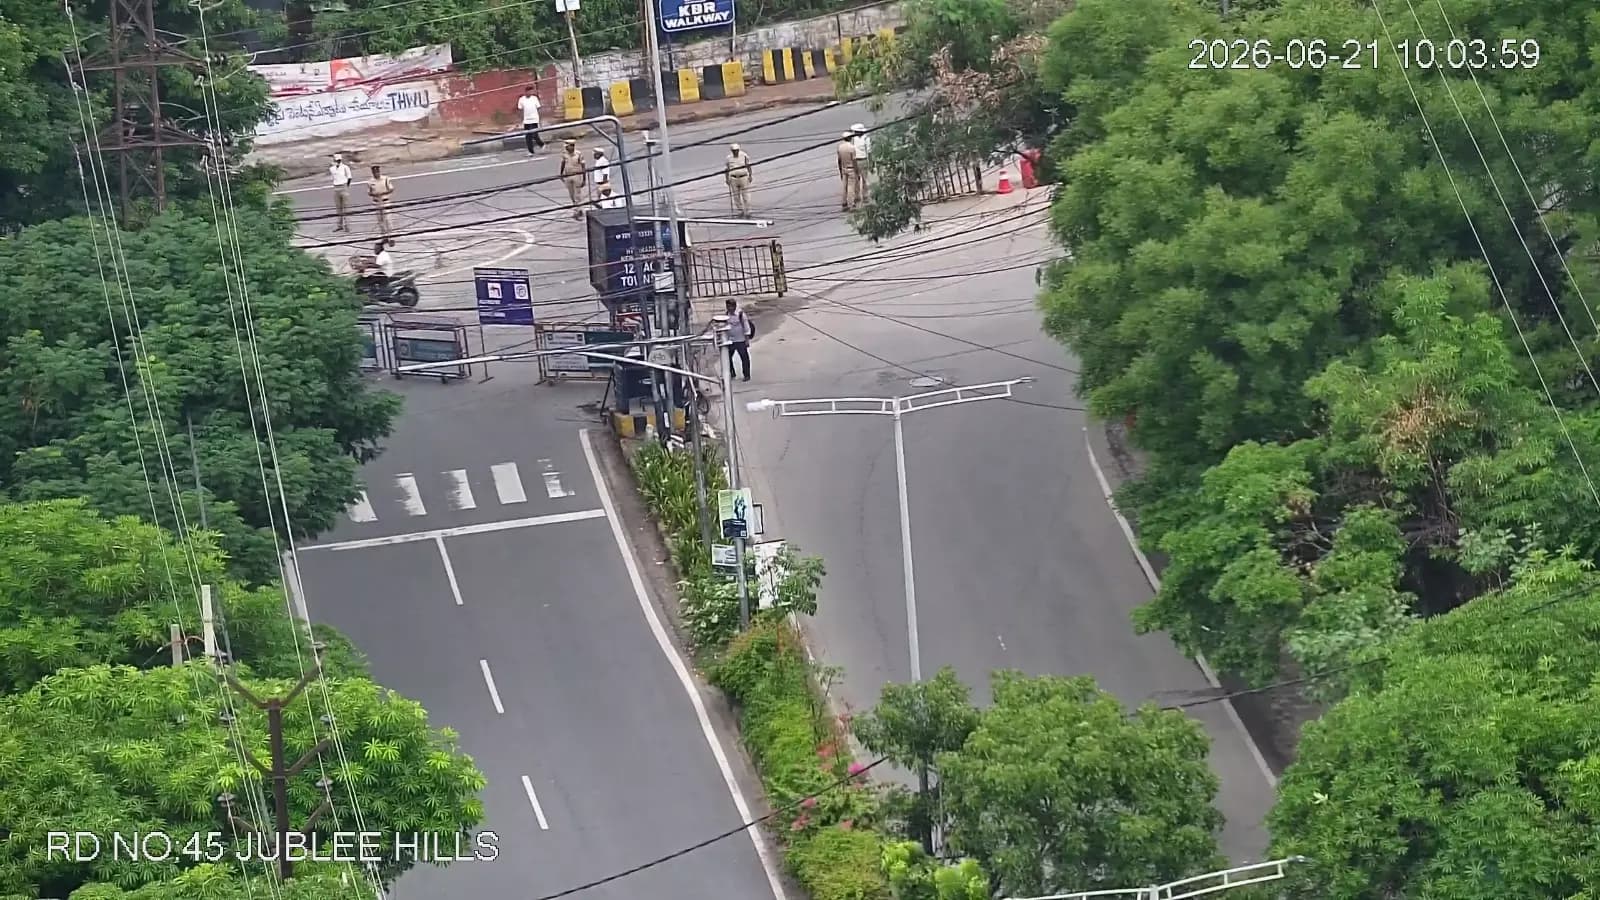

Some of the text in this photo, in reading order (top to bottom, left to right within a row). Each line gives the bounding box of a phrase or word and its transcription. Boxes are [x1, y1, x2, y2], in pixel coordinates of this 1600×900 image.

[679, 2, 715, 17] KBR
[665, 11, 729, 28] WALKWAY
[624, 263, 636, 274] 12
